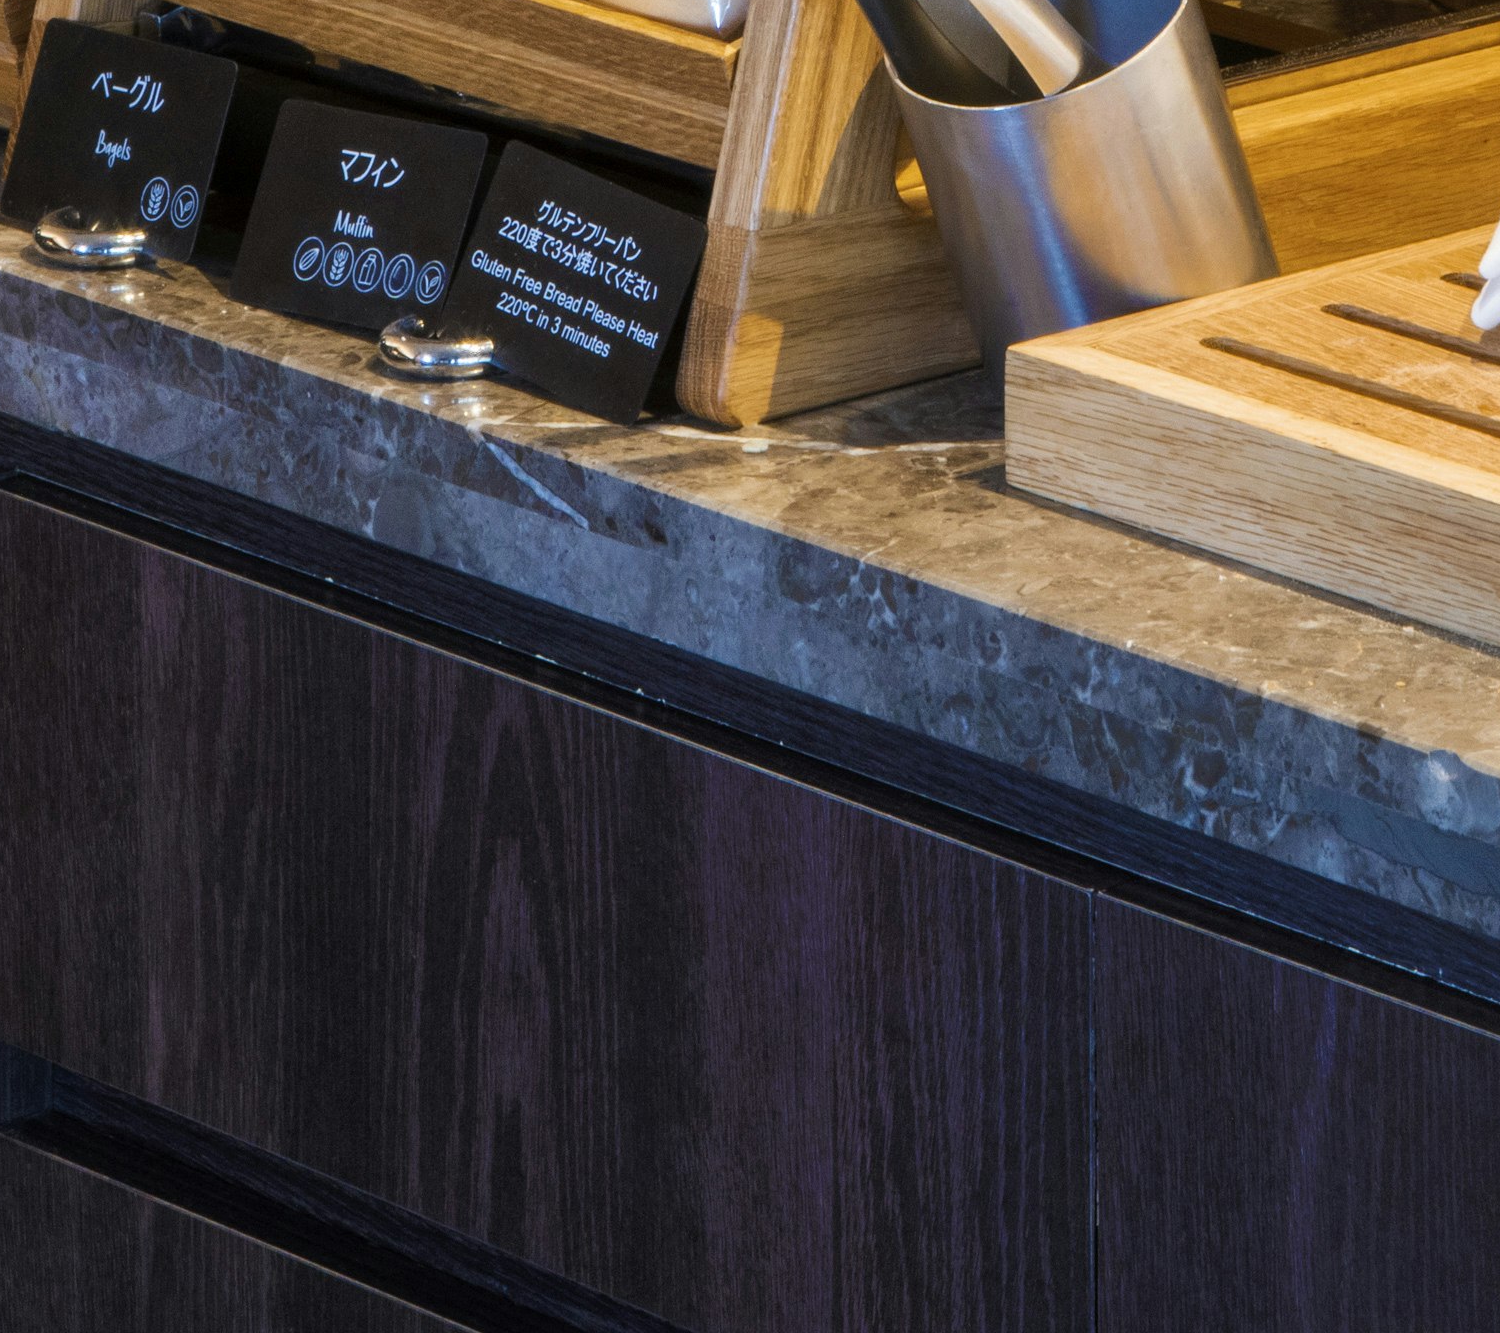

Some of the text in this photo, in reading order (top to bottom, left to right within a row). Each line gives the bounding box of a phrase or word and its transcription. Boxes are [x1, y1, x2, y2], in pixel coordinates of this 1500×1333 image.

[91, 71, 165, 113] ベーグル
[94, 129, 131, 169] Bagels
[340, 149, 406, 188] マフィン
[333, 210, 374, 239] Muffin
[537, 199, 642, 262] グルテンフリーパン
[498, 216, 658, 302] 220度で3分焼いてください
[471, 249, 659, 350] Gluten Free Bread Please Heat
[536, 310, 549, 330] in
[550, 317, 560, 335] 3
[561, 324, 611, 358] minutes
